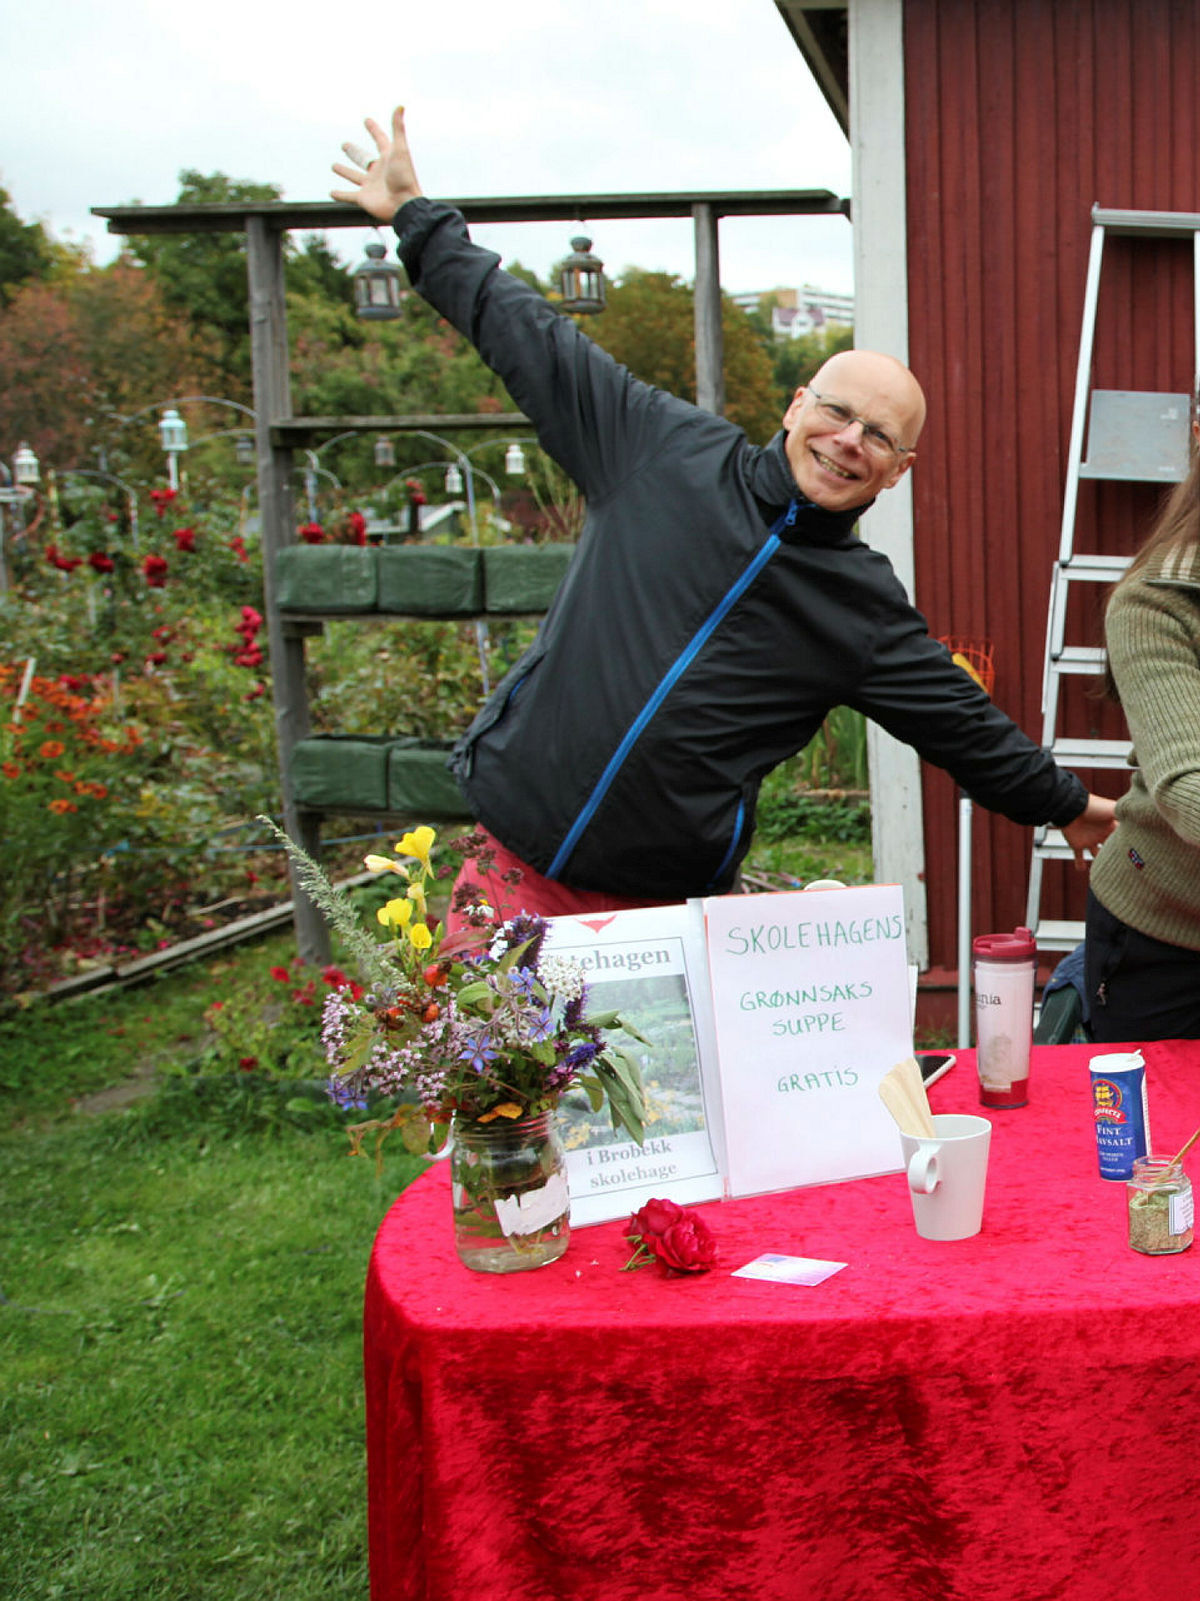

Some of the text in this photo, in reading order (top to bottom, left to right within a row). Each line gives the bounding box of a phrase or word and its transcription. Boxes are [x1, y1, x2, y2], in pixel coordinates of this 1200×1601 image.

[726, 914, 903, 956] SKOLEHAGENS
[739, 980, 873, 1012] GRØNNSAKS
[771, 1011, 846, 1037] SUPPE
[1096, 1123, 1122, 1137] FINT
[586, 1139, 673, 1166] i Brobekk
[589, 1163, 678, 1189] skolehage
